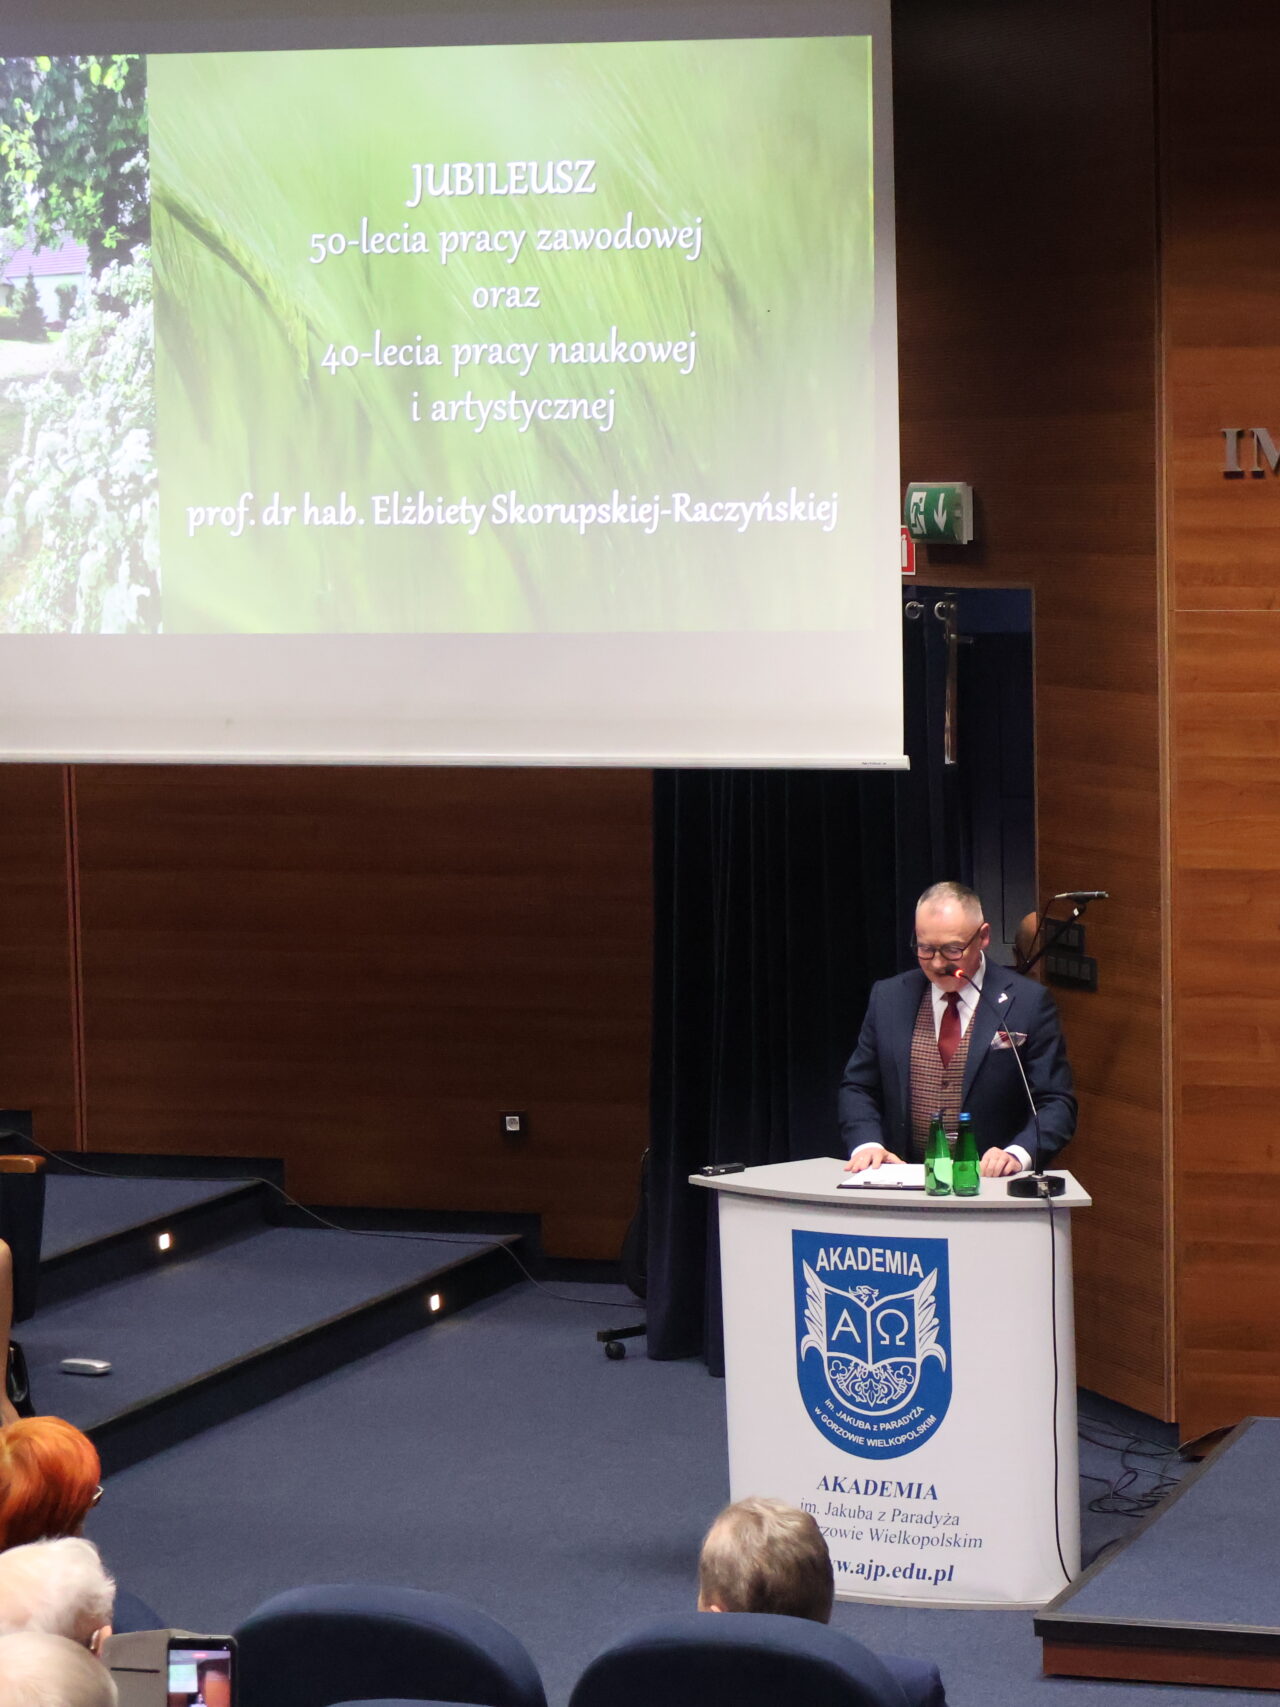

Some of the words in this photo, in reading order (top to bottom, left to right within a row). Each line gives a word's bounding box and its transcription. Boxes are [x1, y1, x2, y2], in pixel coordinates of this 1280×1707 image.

[406, 159, 597, 208] JUBILEUSZ
[308, 217, 430, 264] 50-lecia
[440, 228, 526, 265] pracy
[536, 211, 704, 261] zawodowej
[472, 285, 541, 309] oraz
[320, 329, 442, 376] 40-lecia
[452, 340, 539, 377] pracy
[548, 325, 698, 375] naukowej
[411, 392, 421, 423] i
[430, 389, 617, 433] artystycznej
[186, 492, 256, 537] prof.
[262, 492, 297, 526] dr
[303, 491, 366, 526] hab.
[371, 490, 487, 536] Elżbiety
[491, 487, 839, 535] Skorupskiej-Raczyńskiej
[815, 1246, 925, 1279] AKADEMIA
[820, 1413, 865, 1446] GORZOWIE
[866, 1414, 937, 1448] WIELKOPOLSKIM
[835, 1410, 871, 1432] JAKUBA
[879, 1405, 925, 1432] PARADYŻA
[816, 1475, 938, 1501] AKADEMIA
[824, 1501, 873, 1521] Jakuba
[877, 1511, 886, 1522] z
[891, 1508, 960, 1529] Paradyża
[869, 1527, 983, 1550] Wielkopolskim
[829, 1559, 955, 1586] w.ajp.edu.pl
